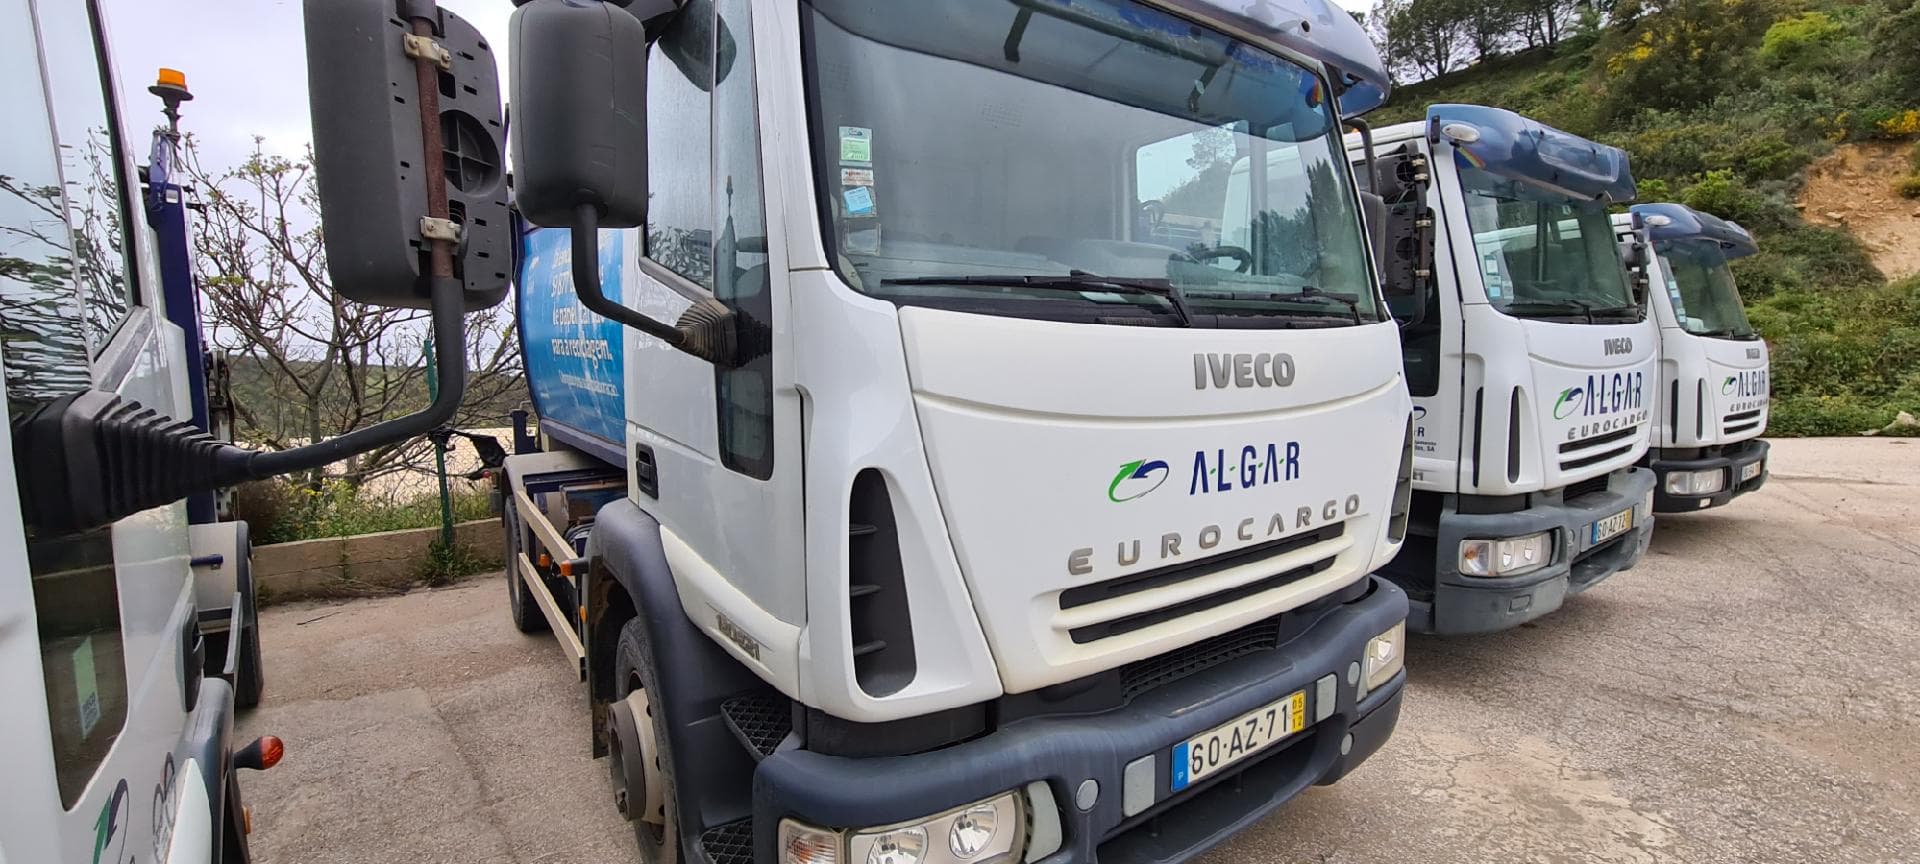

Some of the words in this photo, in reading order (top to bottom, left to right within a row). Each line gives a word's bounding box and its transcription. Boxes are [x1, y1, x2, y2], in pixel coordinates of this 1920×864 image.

[1603, 337, 1632, 356] IVECO
[1194, 353, 1296, 390] IVECO
[1567, 409, 1648, 440] EUROCARGO
[1068, 494, 1361, 576] EUROCARGO
[1292, 698, 1303, 710] 05
[1177, 771, 1184, 780] P
